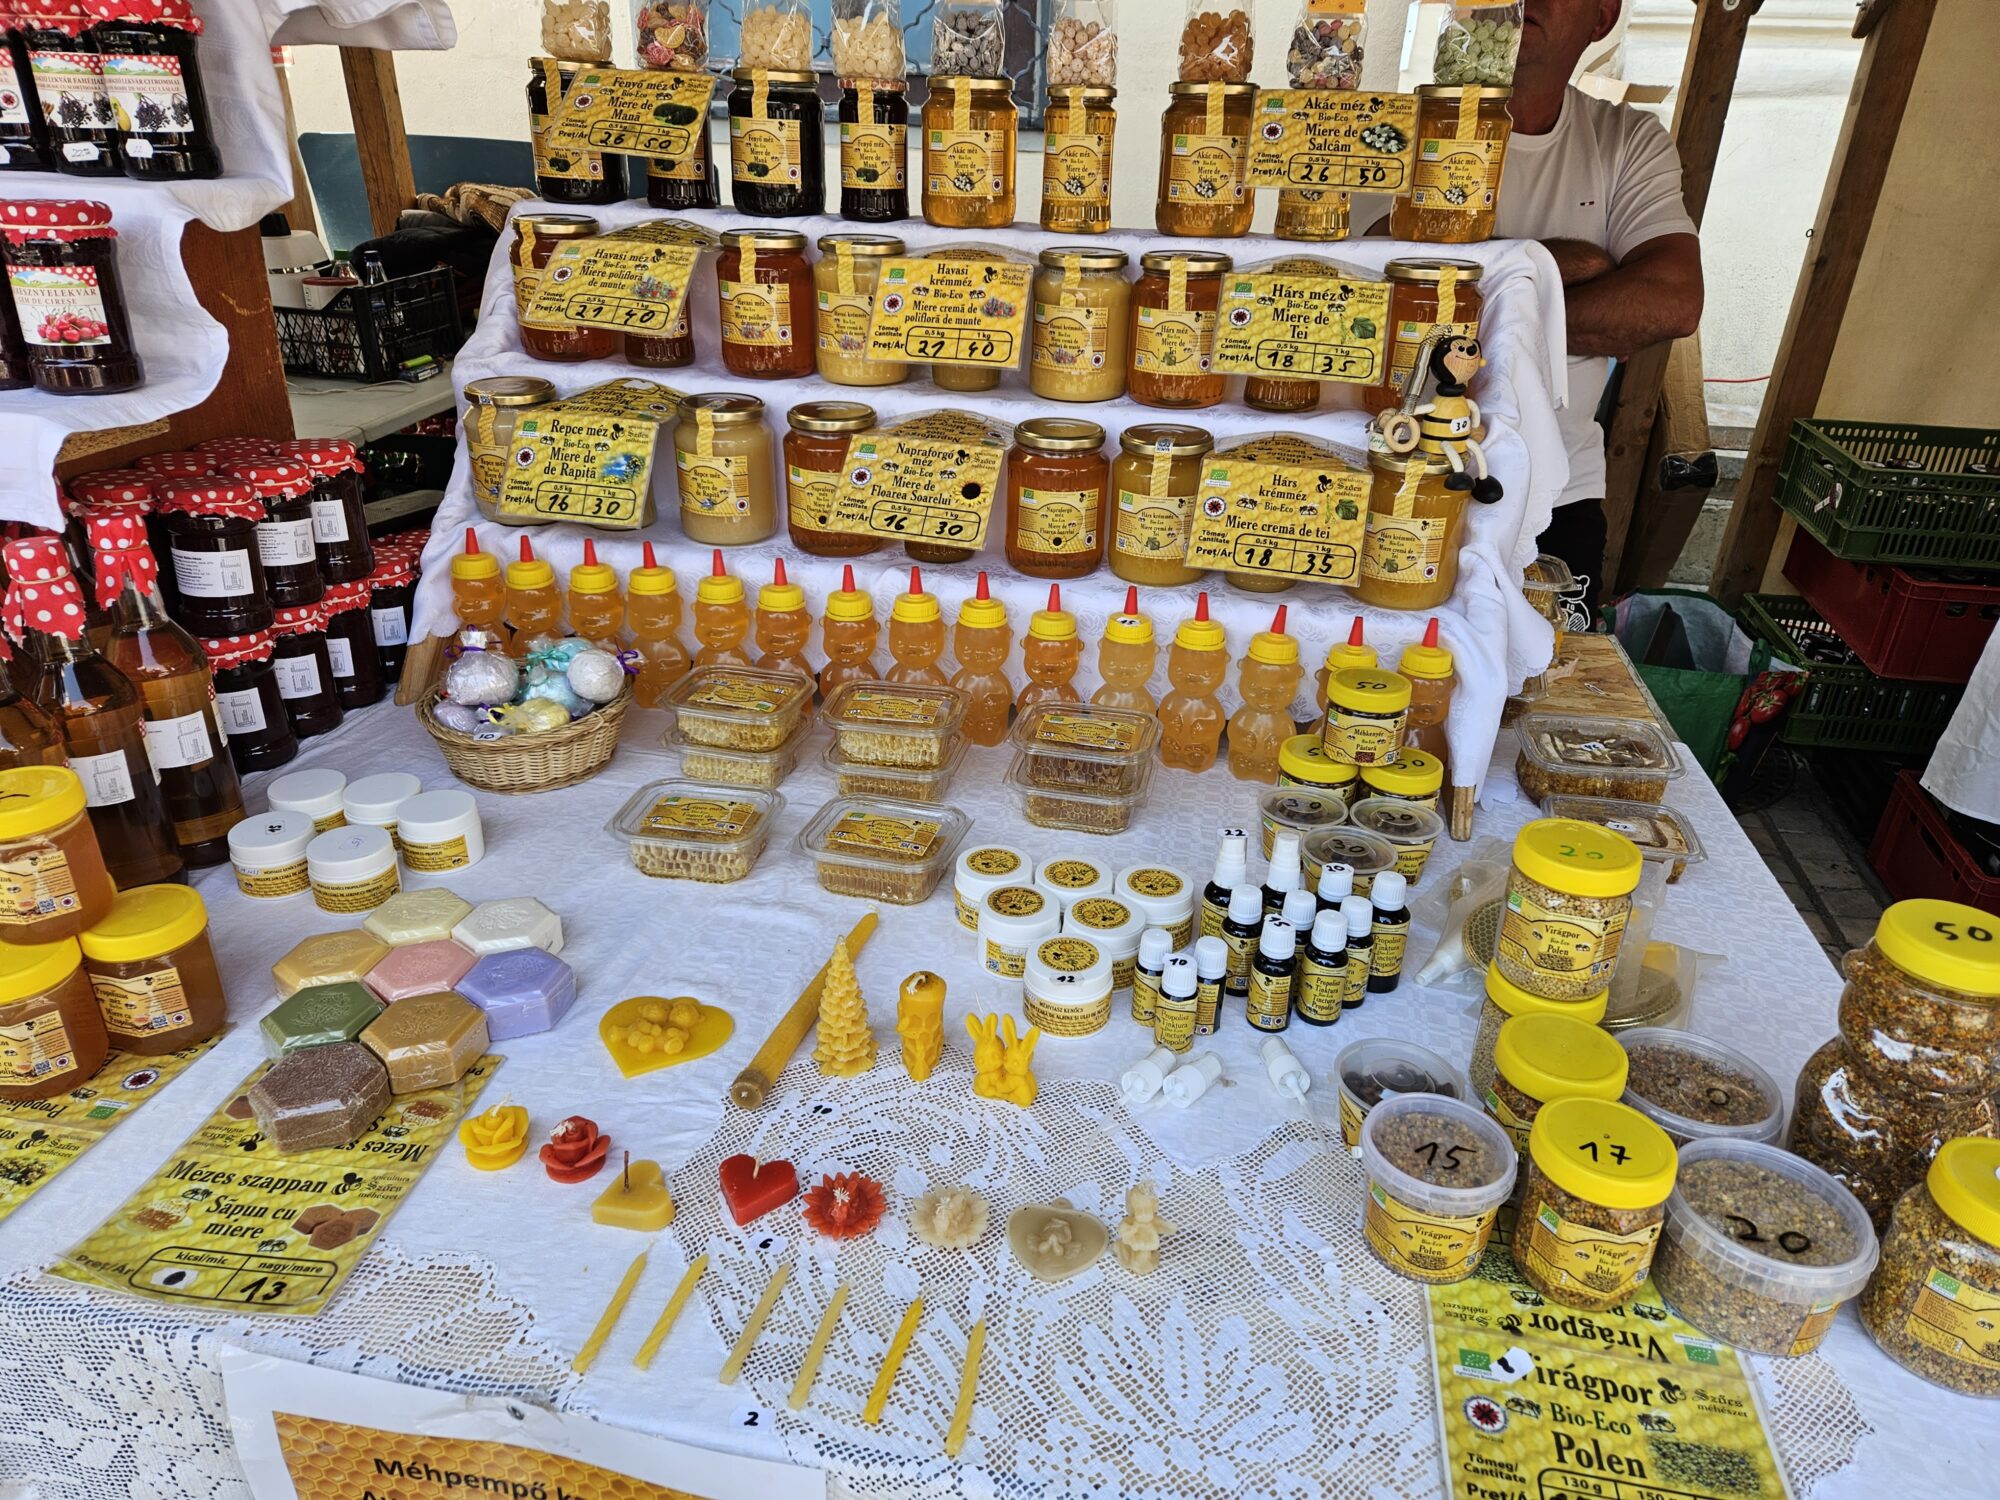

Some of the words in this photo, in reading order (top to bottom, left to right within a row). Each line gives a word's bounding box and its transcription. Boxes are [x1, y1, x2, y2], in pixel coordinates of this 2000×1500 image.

[613, 77, 646, 89] Fenyő
[647, 83, 668, 91] méz
[622, 90, 648, 98] Bio-Eco
[608, 96, 638, 110] Miere
[641, 100, 653, 110] de
[1304, 97, 1336, 110] Akác
[1342, 100, 1365, 112] méz
[1318, 113, 1349, 121] Bio-Eco
[1305, 123, 1340, 137] Miere
[1344, 125, 1358, 137] de
[600, 131, 625, 145] 26
[644, 138, 672, 149] 50
[1308, 138, 1351, 152] Salcâm
[1300, 164, 1329, 182] 26
[1360, 166, 1386, 185] 50
[595, 249, 628, 260] Havasi
[630, 254, 649, 263] méz
[579, 266, 606, 277] Miere
[603, 261, 627, 269] Bio-Eco
[937, 264, 969, 275] Havasi
[588, 278, 598, 287] de
[930, 275, 972, 287] krémméz
[934, 289, 963, 299] Bio-Eco
[1272, 284, 1304, 298] Hárs
[1309, 290, 1337, 301] méz
[576, 305, 603, 318] 21
[912, 300, 937, 312] Miere
[968, 302, 977, 313] de
[1287, 301, 1318, 310] Bio-Eco
[624, 309, 655, 326] 40
[943, 315, 953, 324] de
[955, 317, 981, 326] munte
[1272, 308, 1310, 323] Miere
[1315, 311, 1329, 325] de
[1290, 324, 1308, 339] Tei
[918, 340, 945, 357] 21
[968, 342, 994, 357] 40
[1267, 351, 1293, 367] 18
[1321, 357, 1356, 373] 35
[551, 419, 583, 436] Repce
[586, 424, 608, 437] méz
[563, 439, 590, 449] Bio-Eco
[896, 443, 954, 460] Napraforgó
[550, 447, 581, 462] Miere
[584, 450, 596, 463] de
[912, 457, 933, 467] méz
[543, 462, 556, 475] de
[903, 466, 934, 478] Bio-Eco
[892, 476, 921, 490] Miere
[924, 480, 935, 491] de
[1272, 474, 1297, 488] Hárs
[870, 485, 907, 501] Floarea
[910, 490, 952, 506] Soarelui
[1258, 486, 1307, 501] krémméz
[549, 494, 569, 511] 16
[592, 498, 621, 515] 30
[1264, 502, 1293, 513] Bio-Eco
[884, 514, 908, 531] 16
[935, 521, 963, 536] 30
[1225, 515, 1258, 531] Miere
[1299, 523, 1312, 537] de
[1316, 527, 1331, 539] tei
[1198, 536, 1230, 544] Cantitate
[1245, 548, 1272, 566] 18
[1321, 546, 1331, 554] kg
[1303, 554, 1335, 574] 35
[1393, 759, 1424, 769] 50
[1287, 799, 1321, 809] 30
[1379, 812, 1413, 821] 30
[1332, 839, 1365, 853] 30
[1559, 845, 1604, 859] 20
[1545, 925, 1580, 939] Virágpor
[1934, 922, 1993, 941] 50
[1547, 945, 1569, 955] Polen
[1170, 958, 1188, 967] 10
[362, 1141, 430, 1163] Mézes
[1415, 1142, 1476, 1169] 15
[1579, 1141, 1632, 1165] 17
[165, 1159, 236, 1185] Mézes
[238, 1173, 328, 1194] szappan
[270, 1205, 298, 1221] cu
[201, 1217, 265, 1239] miere
[1415, 1225, 1453, 1240] Virágpor
[1725, 1215, 1811, 1254] 20
[175, 1251, 229, 1265] kicsi/mic
[1419, 1245, 1442, 1256] Polen
[257, 1261, 323, 1274] nagy/mare
[239, 1277, 287, 1302] 13
[1528, 1312, 1672, 1364] Virágpor
[1521, 1352, 1653, 1406] irágpor
[1551, 1401, 1631, 1435] Bio-Eco
[1697, 1404, 1748, 1418] méhészet
[1552, 1430, 1647, 1478] Polen
[1467, 1451, 1518, 1473] Tömeg/
[374, 1457, 548, 1500] Méhpempő
[1463, 1464, 1527, 1484] Cantitate
[1562, 1476, 1589, 1490] 130
[1594, 1481, 1602, 1494] g
